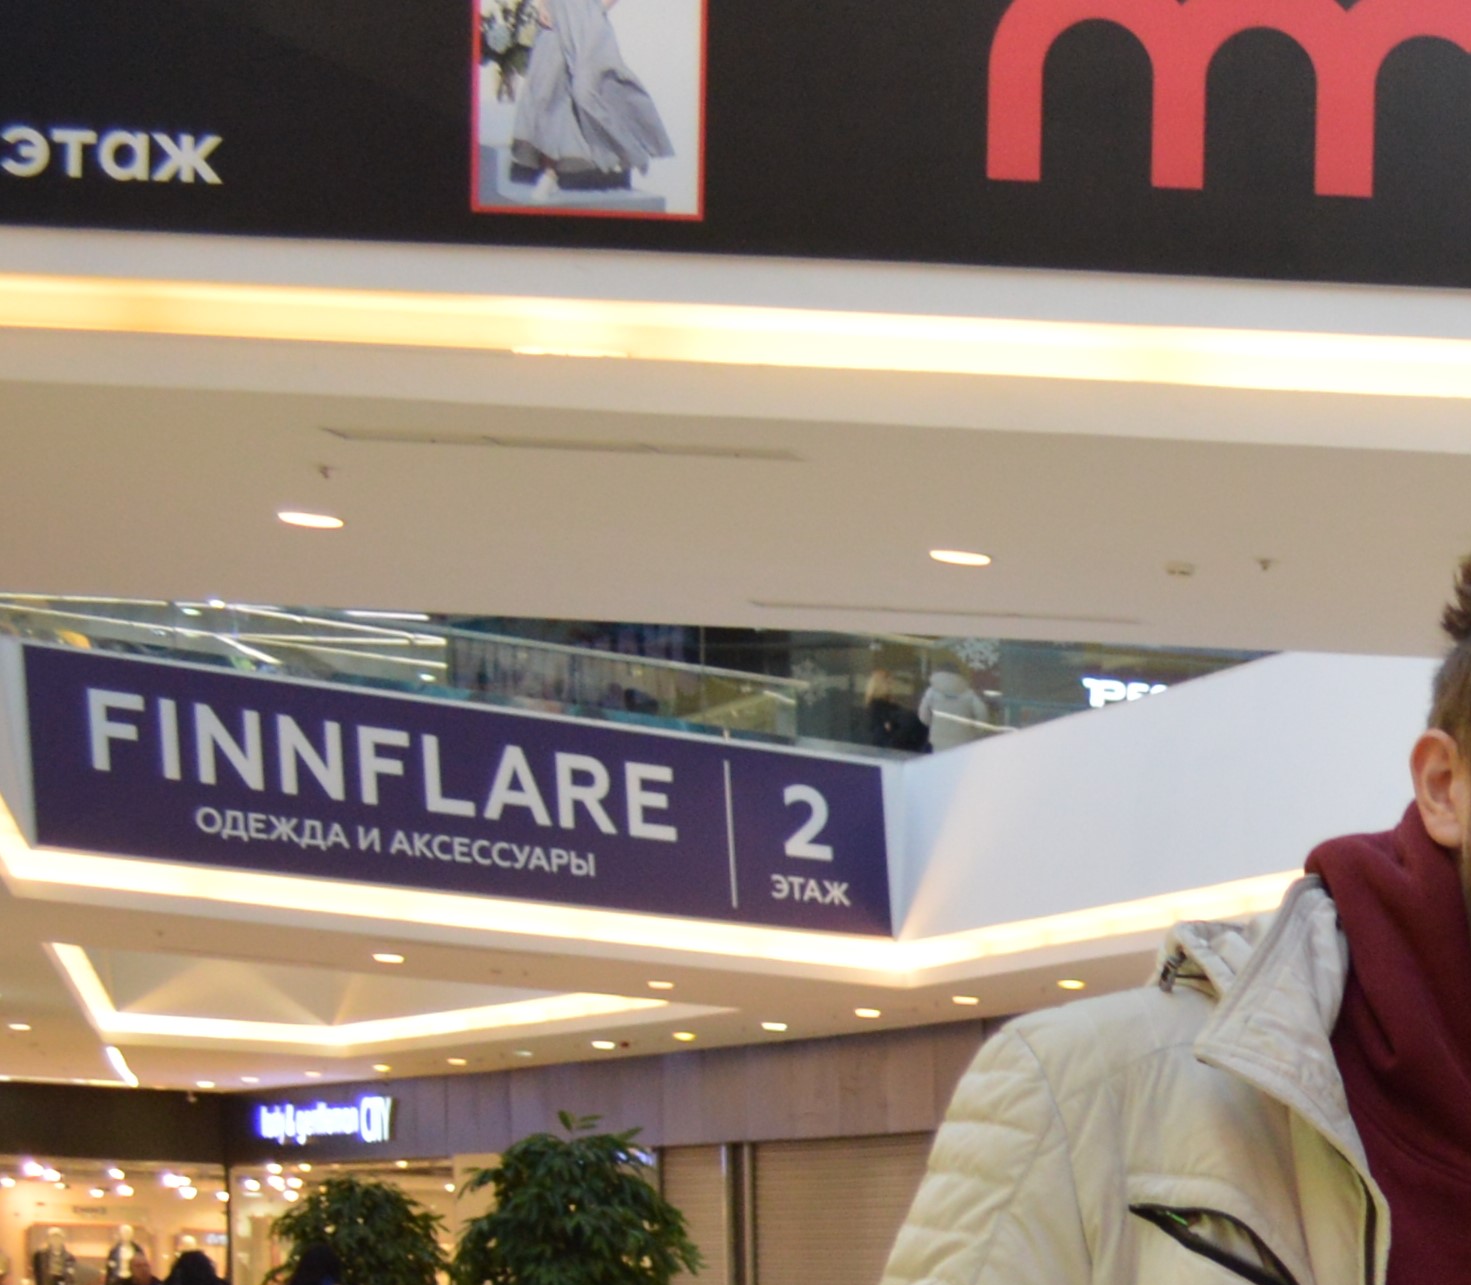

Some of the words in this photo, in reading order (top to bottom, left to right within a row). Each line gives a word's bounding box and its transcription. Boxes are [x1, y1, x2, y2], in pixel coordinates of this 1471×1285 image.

[0, 125, 224, 184] этаж
[86, 687, 679, 843] FINNFLARE
[194, 805, 350, 852] ОДЕЖДА
[357, 823, 382, 852] И
[388, 828, 598, 878] АКСЕССУАРЫ
[781, 783, 835, 861] 2
[770, 872, 850, 909] ЭТАЖ
